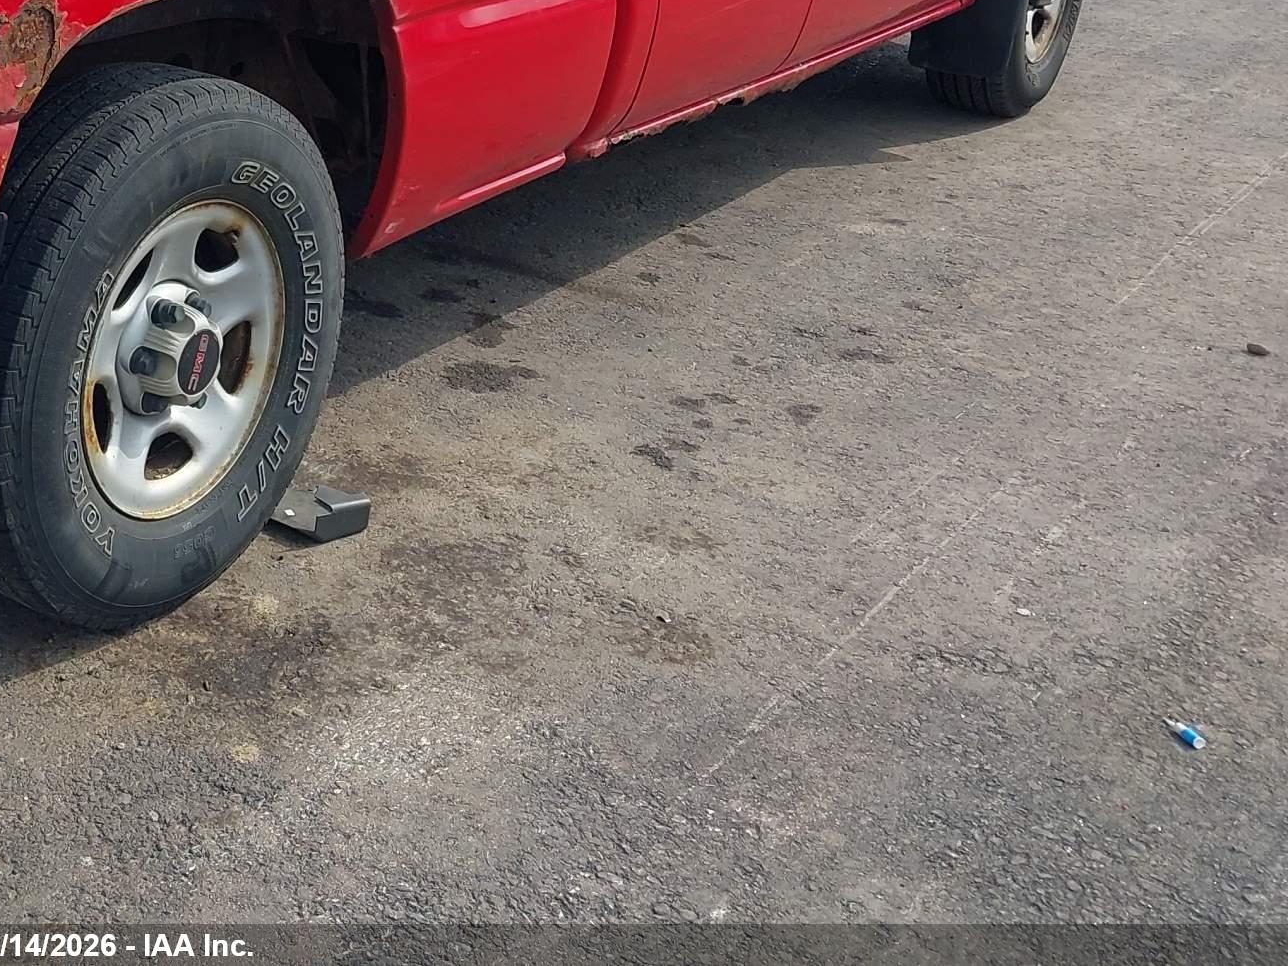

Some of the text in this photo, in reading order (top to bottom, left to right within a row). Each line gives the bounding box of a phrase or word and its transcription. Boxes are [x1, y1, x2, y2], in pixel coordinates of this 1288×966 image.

[62, 268, 115, 559] YOKOHAMA
[187, 333, 210, 392] GMC
[230, 160, 325, 523] GEOLANDAR H/T
